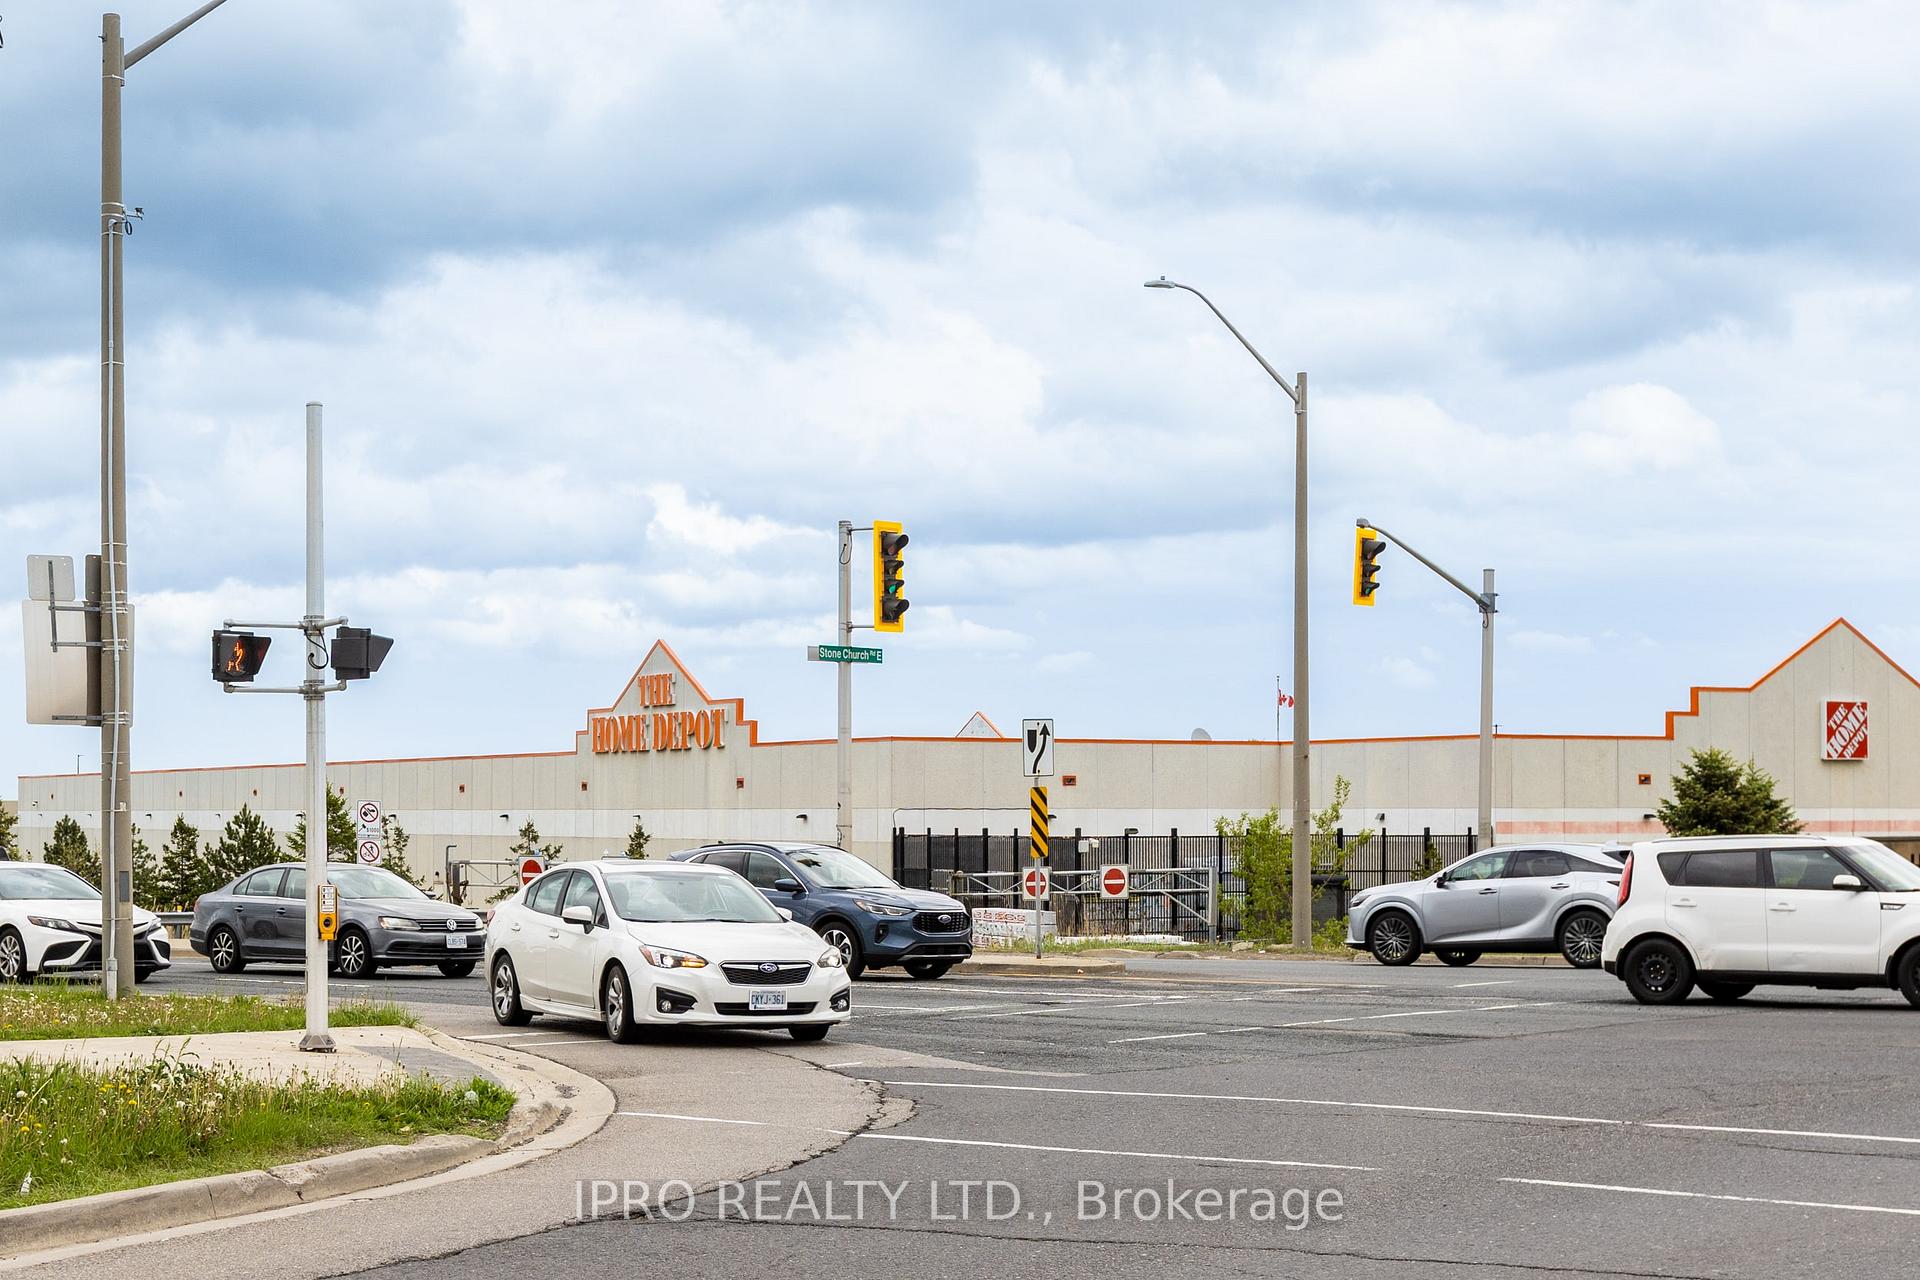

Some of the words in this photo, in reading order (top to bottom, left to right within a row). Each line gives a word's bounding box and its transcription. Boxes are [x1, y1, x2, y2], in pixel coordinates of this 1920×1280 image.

[819, 647, 842, 659] Stone
[842, 648, 869, 660] Church
[876, 651, 882, 661] E
[638, 673, 675, 706] THE
[592, 714, 650, 752] HOME
[652, 709, 728, 750] DEPOT
[1827, 702, 1868, 759] HOME
[1828, 703, 1848, 730] THE
[1843, 723, 1868, 759] DEPOT
